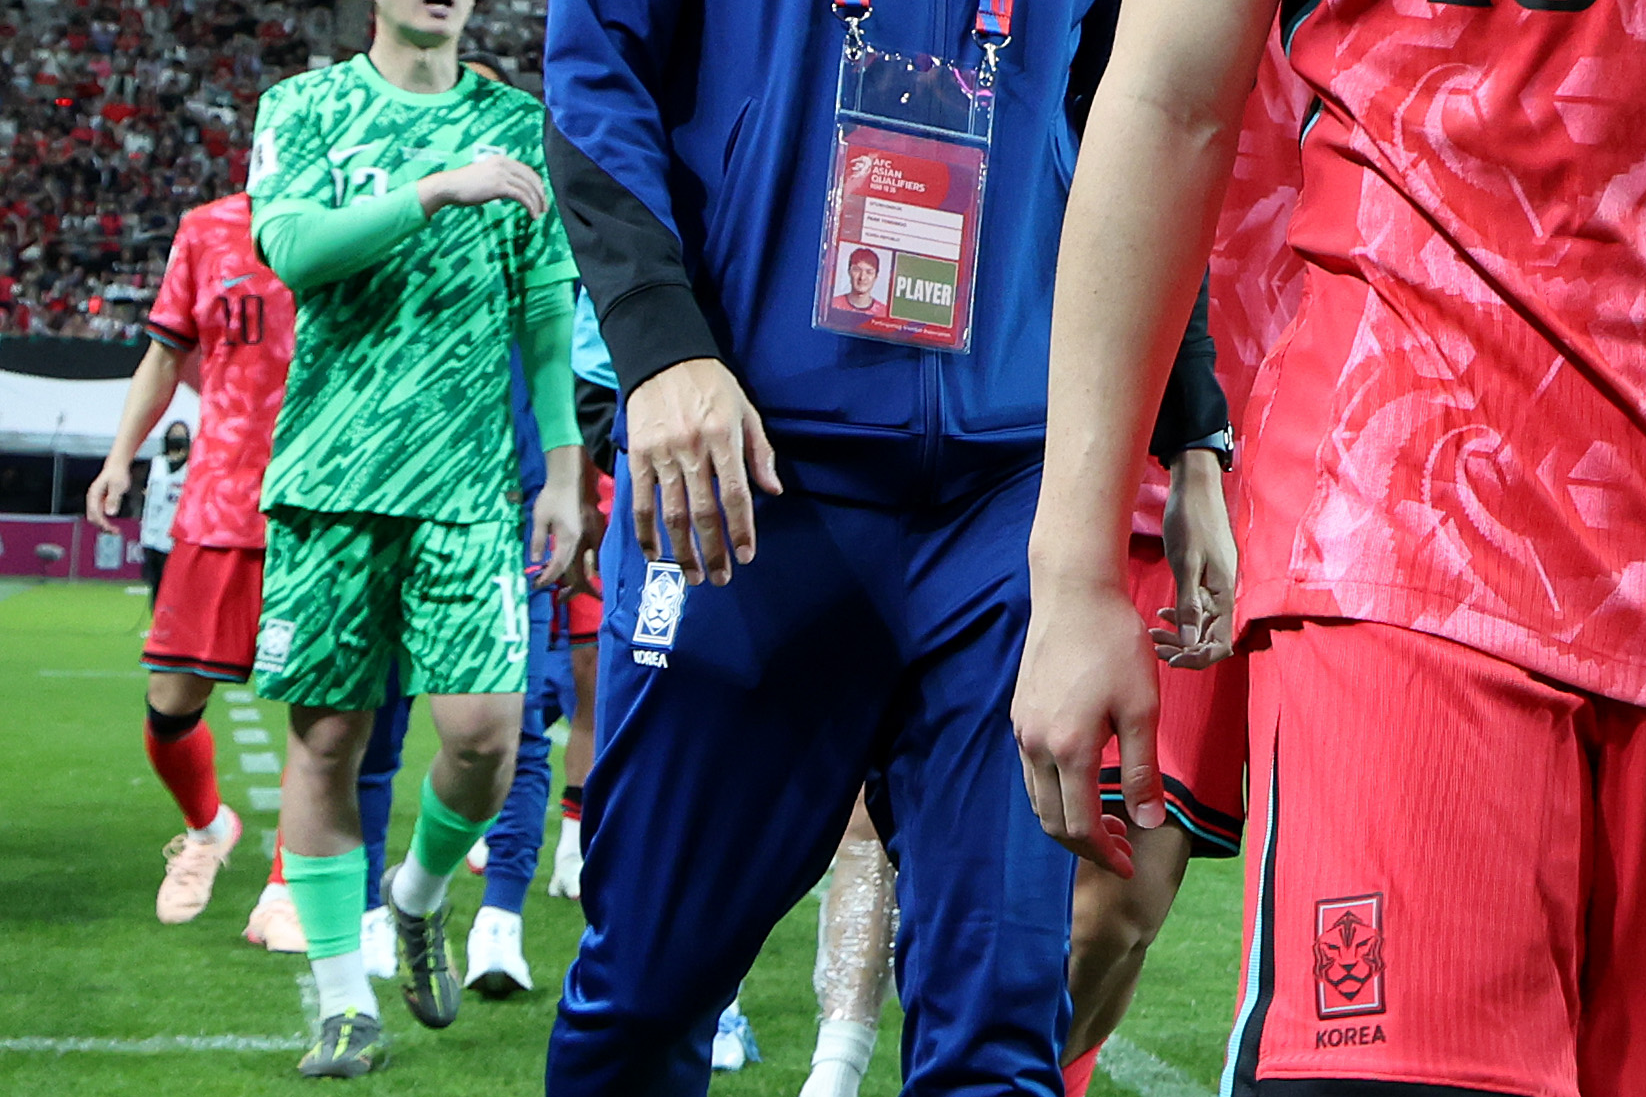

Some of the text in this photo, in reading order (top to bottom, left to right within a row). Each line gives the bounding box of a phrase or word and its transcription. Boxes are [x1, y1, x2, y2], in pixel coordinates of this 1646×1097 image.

[872, 166, 903, 179] ASIAN
[873, 158, 893, 169] AFC
[871, 174, 926, 193] QUALIFIERS
[895, 275, 953, 307] PLAYER
[632, 649, 669, 669] KOREA
[1314, 1024, 1387, 1050] KOREA
